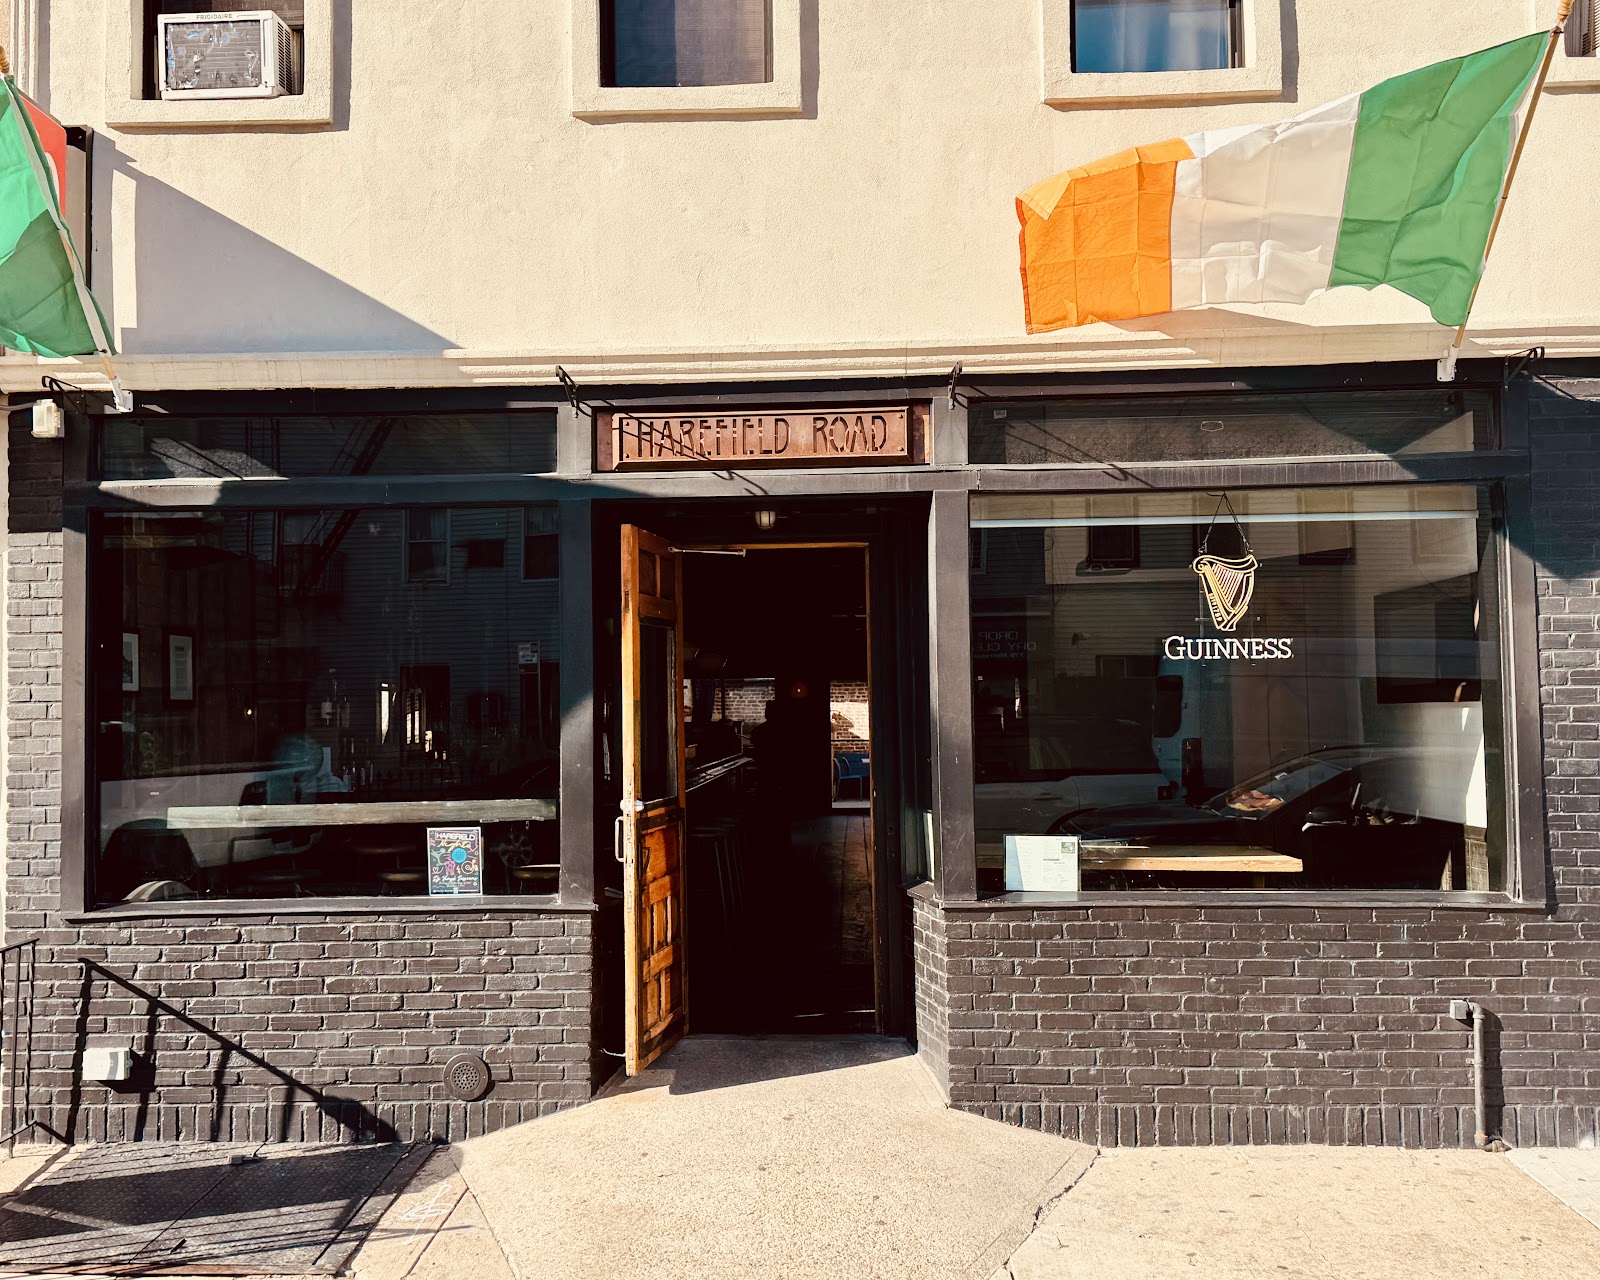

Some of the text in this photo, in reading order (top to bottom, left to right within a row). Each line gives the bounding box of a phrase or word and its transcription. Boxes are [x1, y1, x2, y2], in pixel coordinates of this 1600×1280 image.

[637, 415, 888, 458] HAREFIELD ROAD
[1165, 636, 1292, 660] GUINNESS
[436, 832, 475, 841] HAREFIELD
